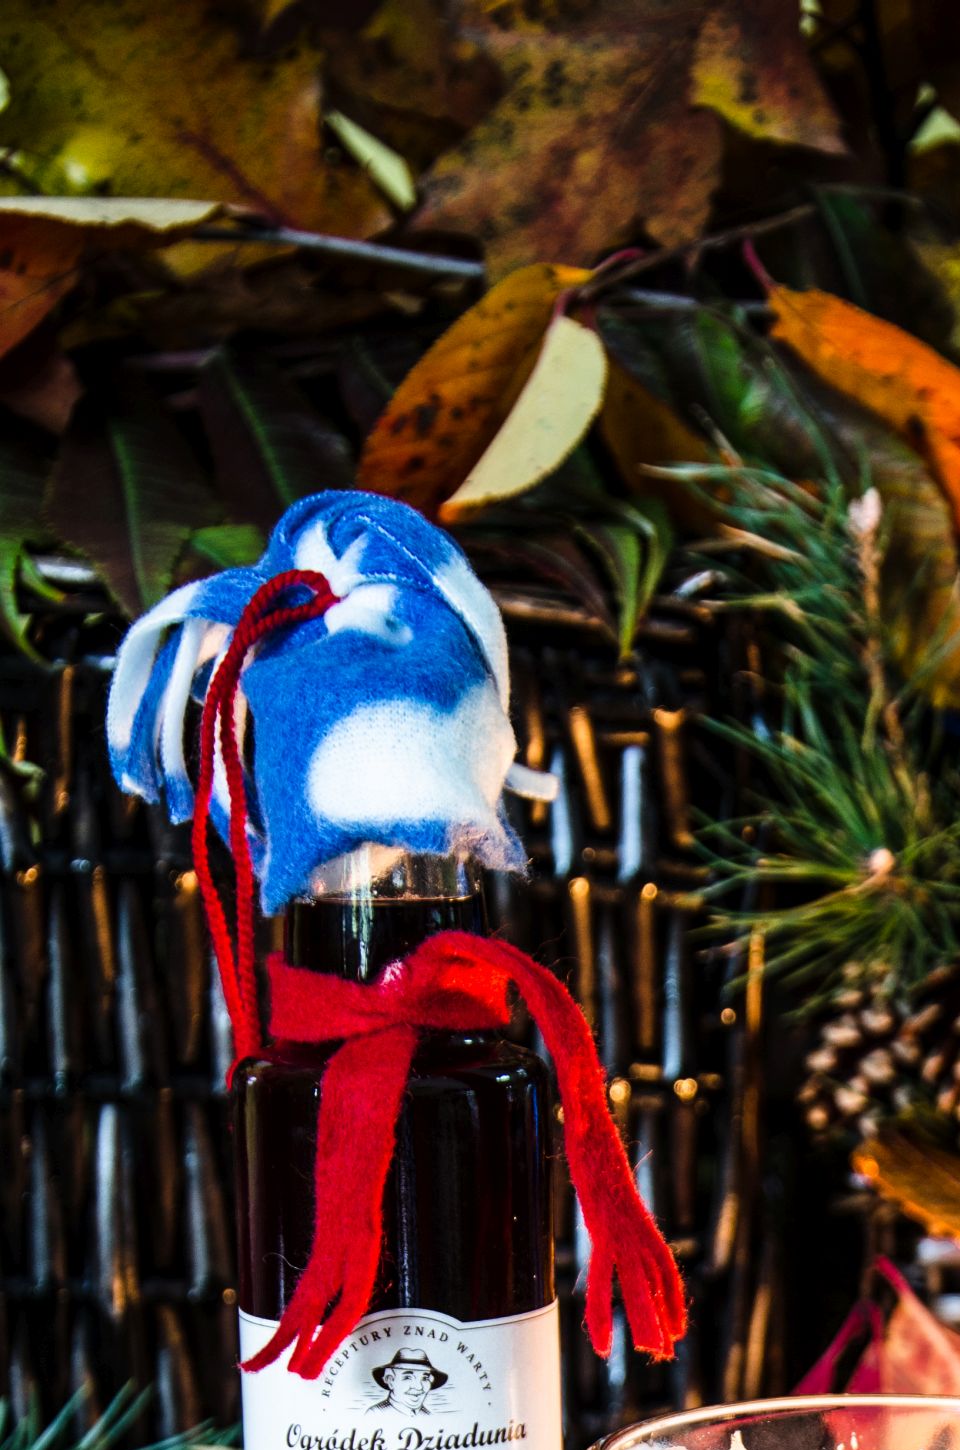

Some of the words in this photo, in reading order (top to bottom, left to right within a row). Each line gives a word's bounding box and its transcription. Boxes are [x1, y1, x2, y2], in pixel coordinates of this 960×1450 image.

[321, 1327, 393, 1399] RECEPTURY
[403, 1325, 449, 1343] ZNAD
[456, 1342, 492, 1392] WARTY
